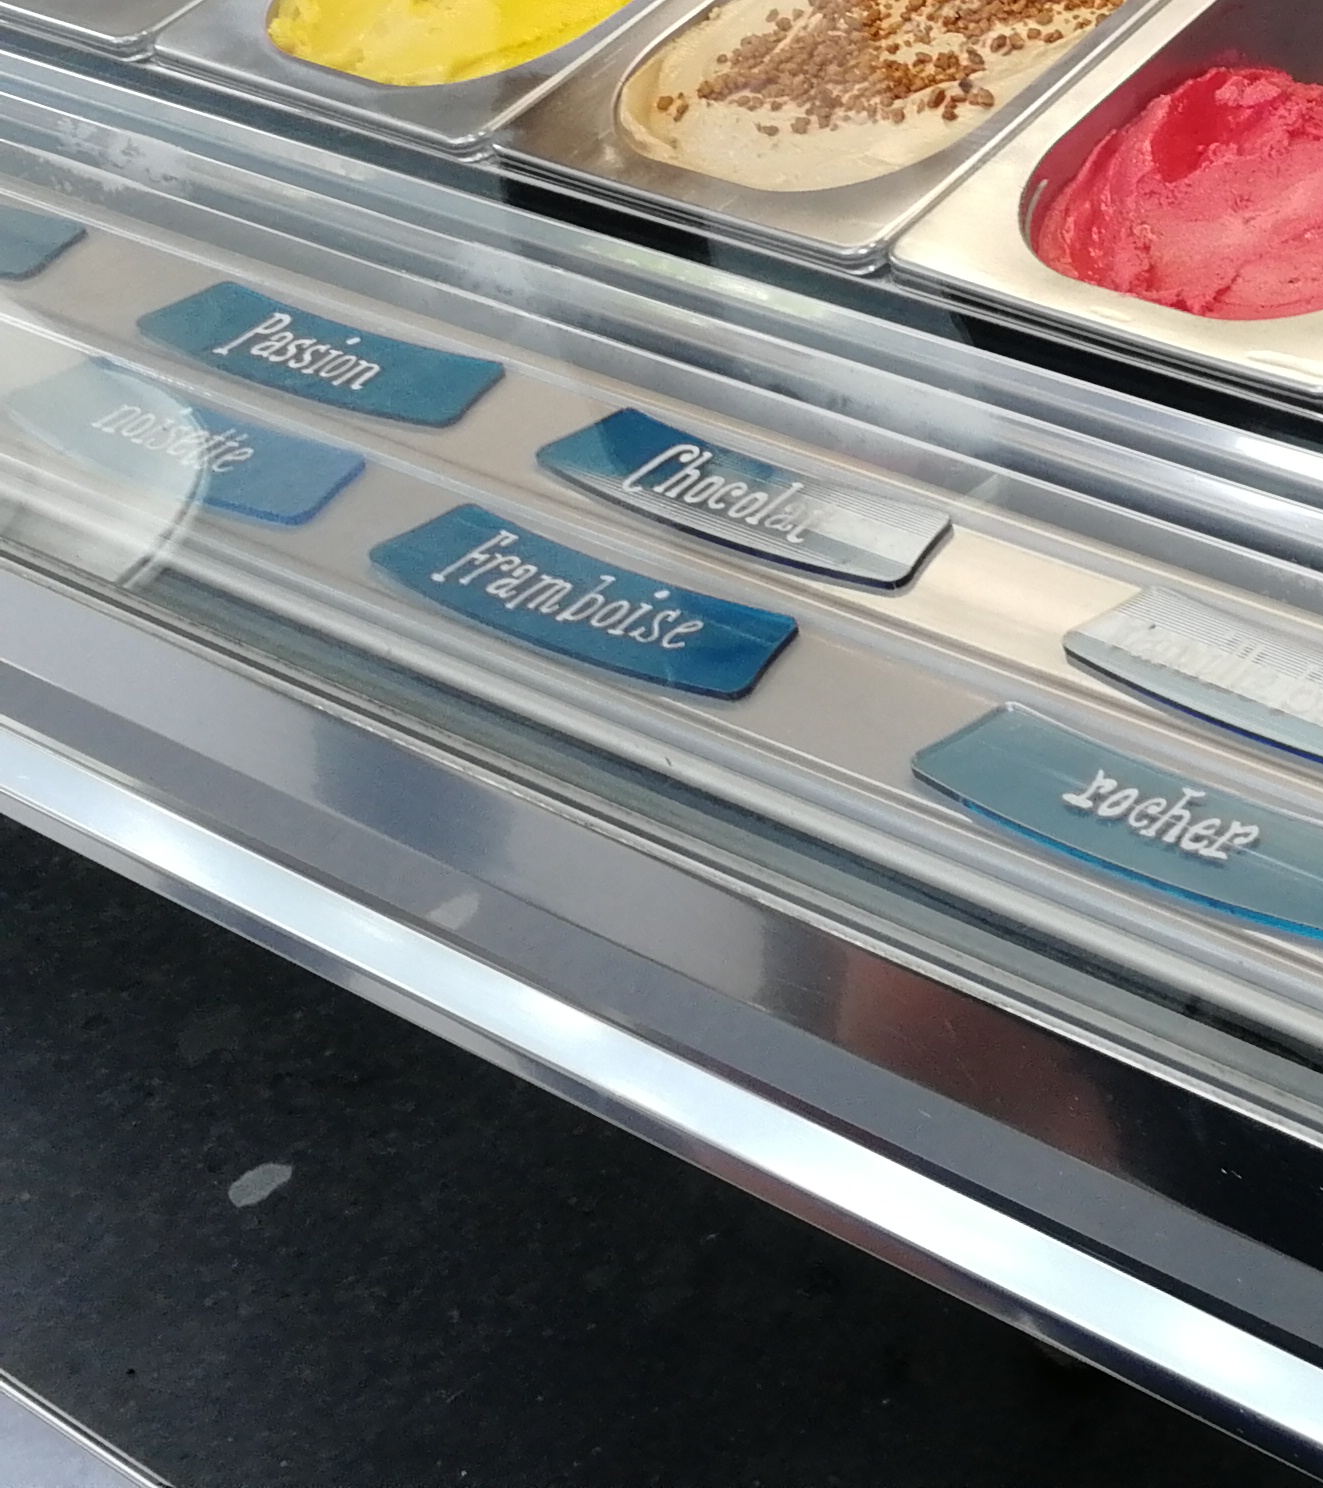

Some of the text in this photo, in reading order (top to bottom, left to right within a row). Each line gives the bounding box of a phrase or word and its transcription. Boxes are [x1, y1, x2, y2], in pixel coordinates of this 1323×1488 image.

[213, 312, 382, 393] Passion
[621, 443, 822, 543] Chocolat
[431, 531, 706, 650] Framboise
[1061, 768, 1261, 861] rocher
